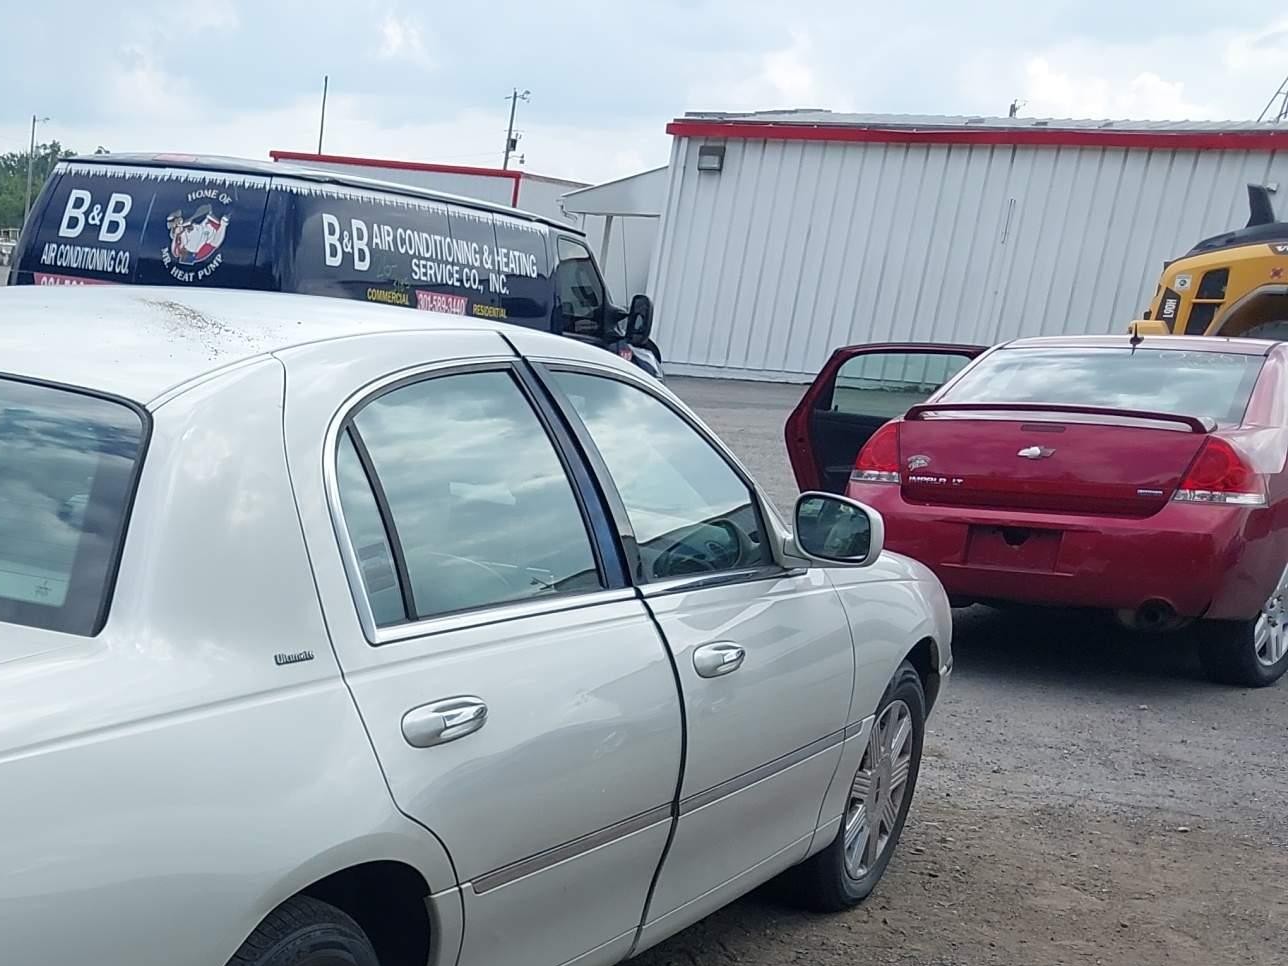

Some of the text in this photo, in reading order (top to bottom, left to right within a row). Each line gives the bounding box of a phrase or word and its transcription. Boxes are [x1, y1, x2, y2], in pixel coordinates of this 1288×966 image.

[187, 189, 233, 205] HOME OF
[58, 189, 132, 242] B&B
[41, 244, 130, 274] AIR CONDITIONING CO.
[322, 213, 538, 279] B&B AIR CONDITIONING & HEATING
[170, 266, 195, 282] HEAT
[197, 253, 223, 280] PUMP
[411, 258, 461, 287] SERVICE
[489, 272, 510, 295] INC.
[367, 287, 409, 305] COMMERCIAL
